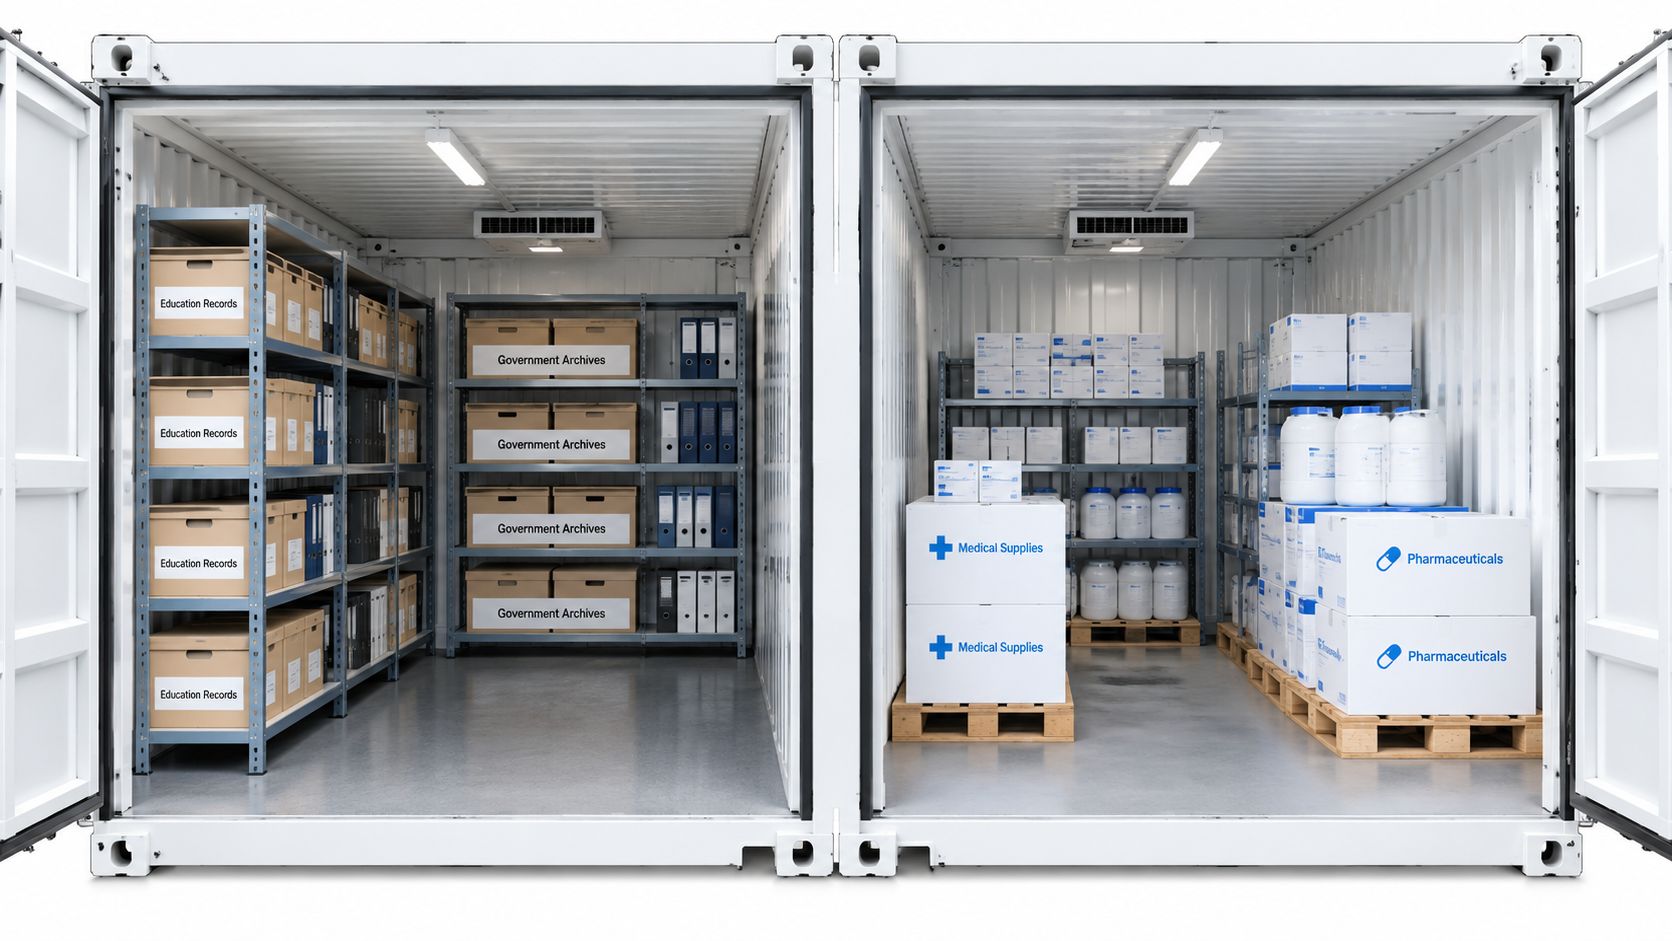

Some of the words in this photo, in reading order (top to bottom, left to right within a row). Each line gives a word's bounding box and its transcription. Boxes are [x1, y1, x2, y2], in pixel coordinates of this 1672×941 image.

[160, 298, 202, 309] Education
[203, 298, 238, 309] Records
[497, 354, 560, 365] Government
[561, 354, 606, 365] Archives
[160, 428, 202, 439] Education
[203, 428, 238, 438] Records
[497, 438, 561, 450] Government
[562, 438, 606, 450] Archives
[497, 522, 561, 534] Government
[561, 523, 606, 534] Archives
[958, 542, 998, 554] Medical
[999, 542, 1044, 556] Supplies
[160, 558, 201, 569] Education
[203, 558, 238, 569] Records
[1407, 552, 1504, 565] Pharmaceuticals
[497, 607, 560, 619] Government
[561, 607, 606, 619] Archives
[958, 641, 998, 653] Medical
[999, 641, 1044, 655] Supplies
[1408, 649, 1508, 663] Pharmaceuticals
[160, 689, 201, 700] Education
[203, 689, 238, 700] Records
